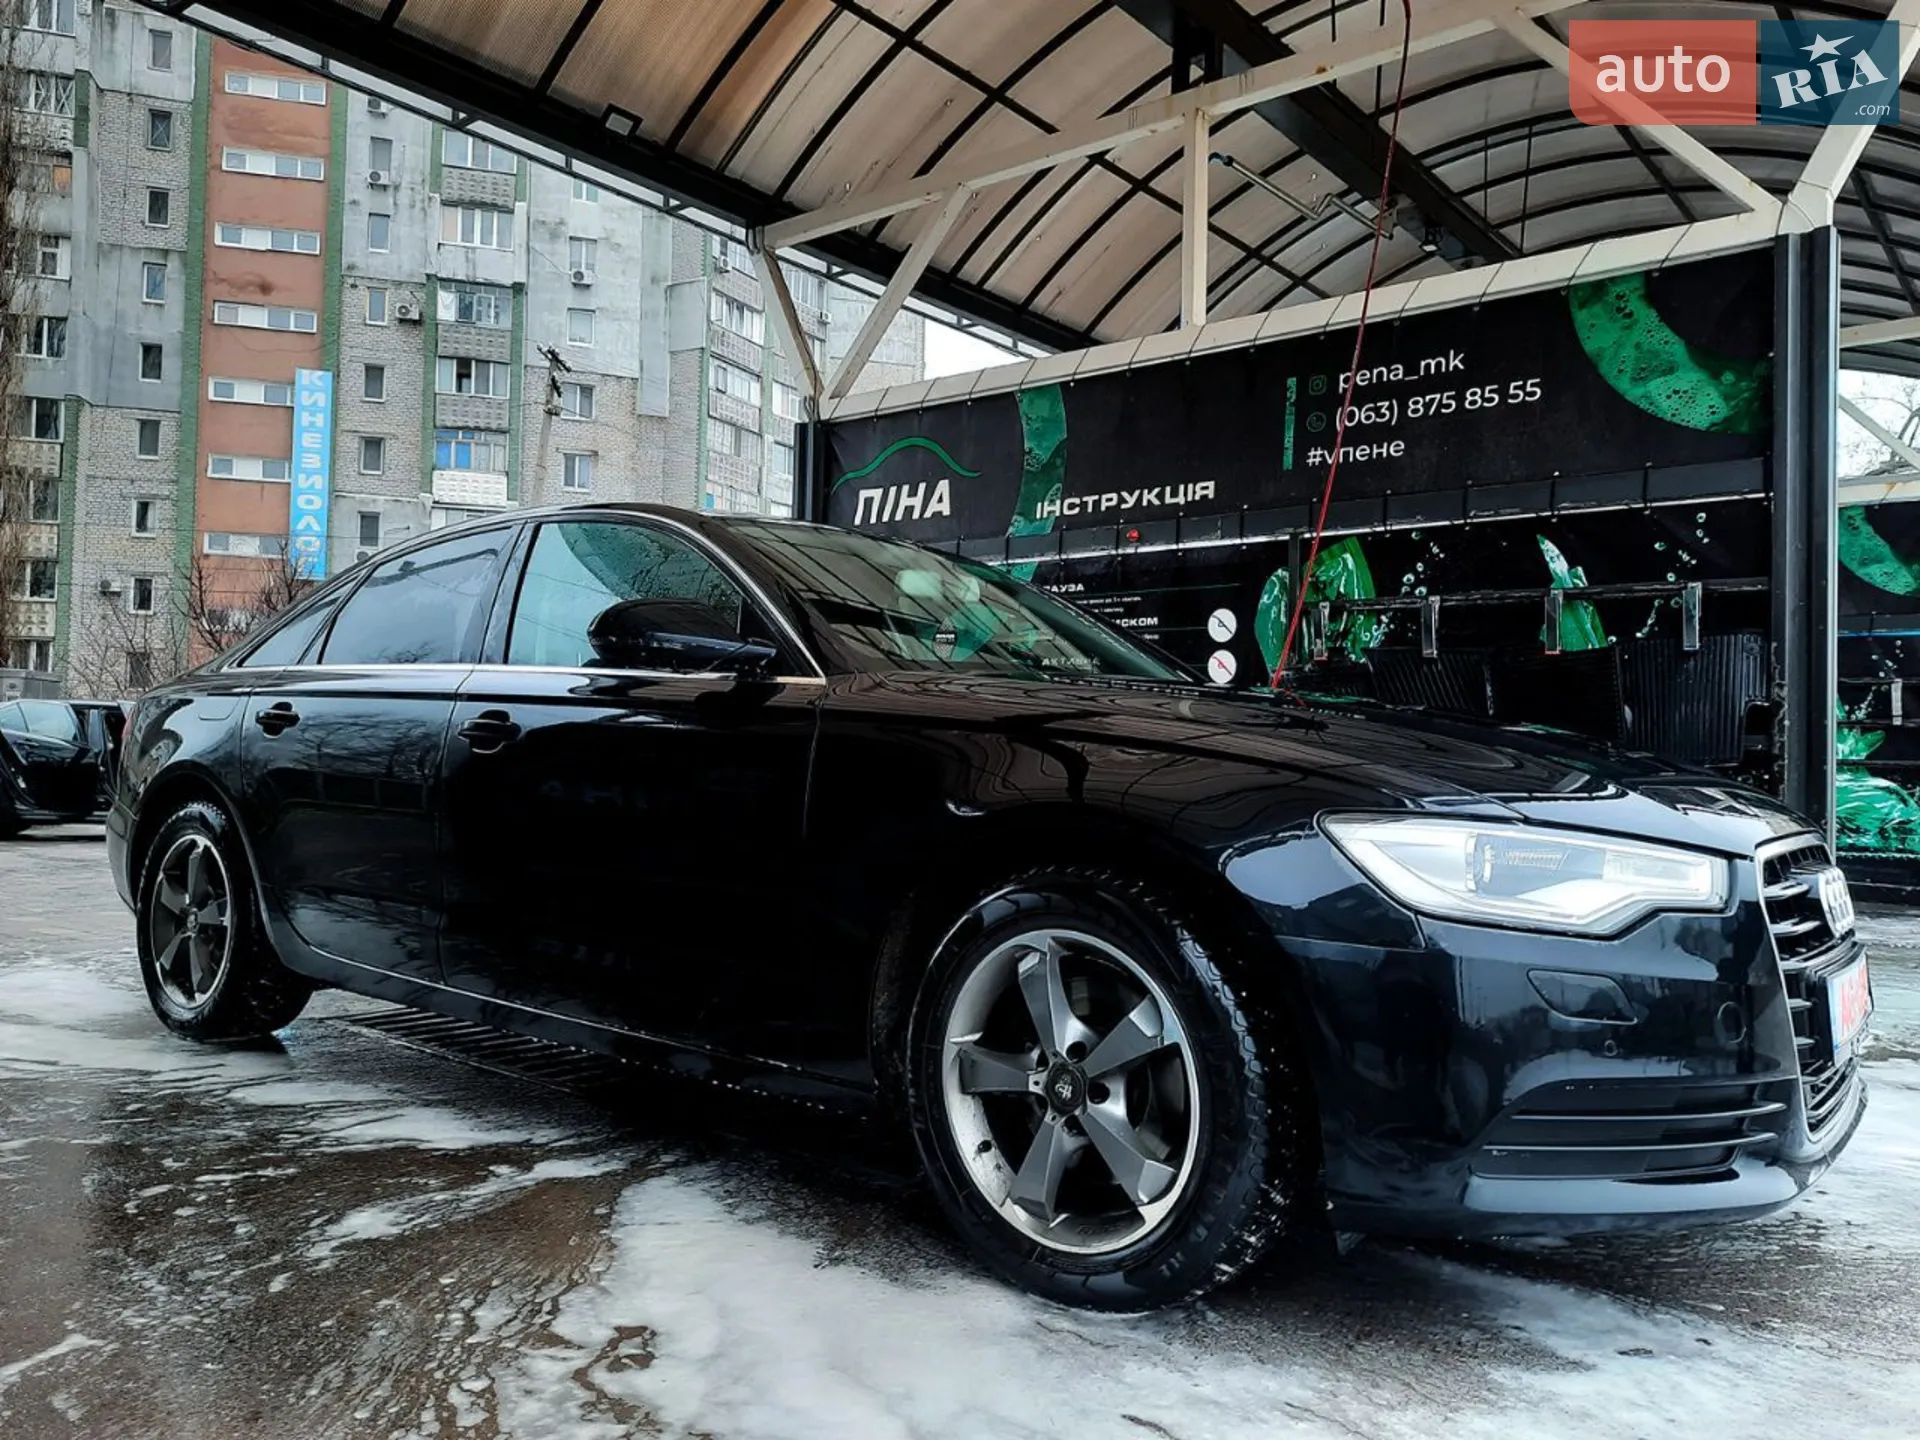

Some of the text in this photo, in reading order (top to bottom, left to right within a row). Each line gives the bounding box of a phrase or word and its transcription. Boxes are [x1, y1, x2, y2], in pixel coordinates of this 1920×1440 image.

[1338, 350, 1466, 394] pena_mk
[1335, 378, 1543, 432] (063) 875 85 55
[854, 479, 952, 526] ПІНА
[1035, 480, 1216, 519] ІНСТРУКЦІЯ
